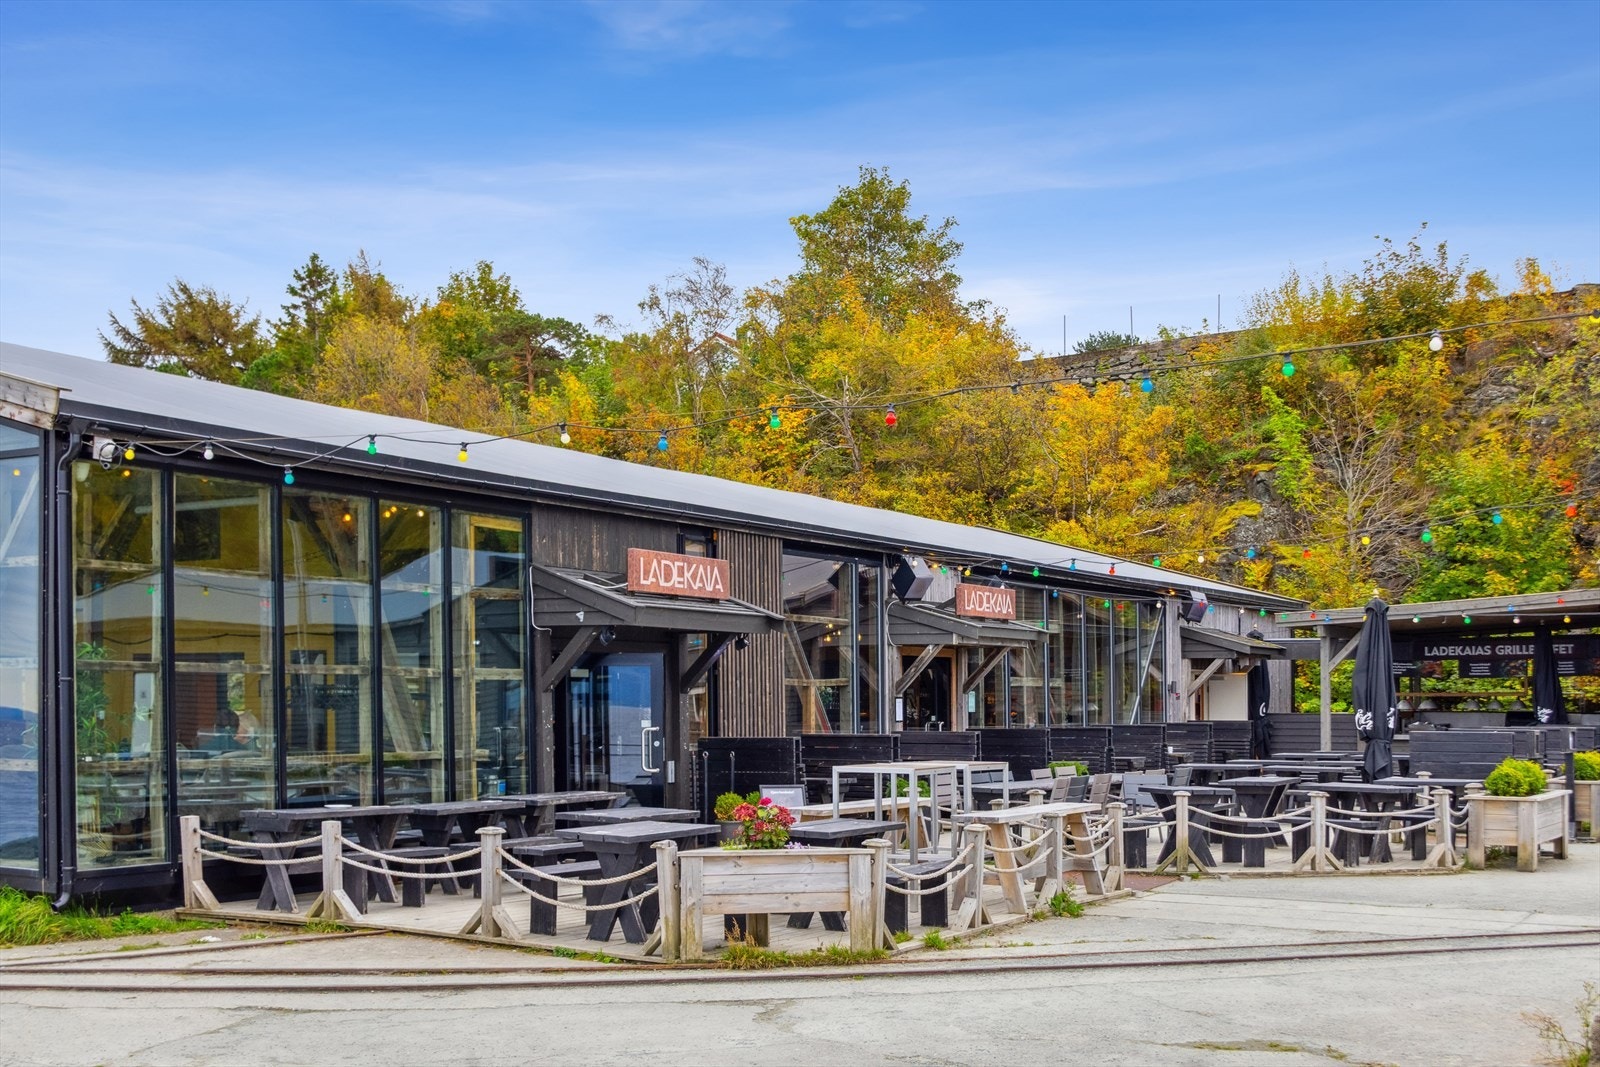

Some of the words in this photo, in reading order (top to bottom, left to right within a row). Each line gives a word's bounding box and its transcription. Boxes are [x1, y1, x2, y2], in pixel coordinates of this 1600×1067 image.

[640, 557, 724, 592] LADEKAIA
[965, 589, 1013, 615] LADEKAIA
[1424, 645, 1492, 657] LADEKAIAS
